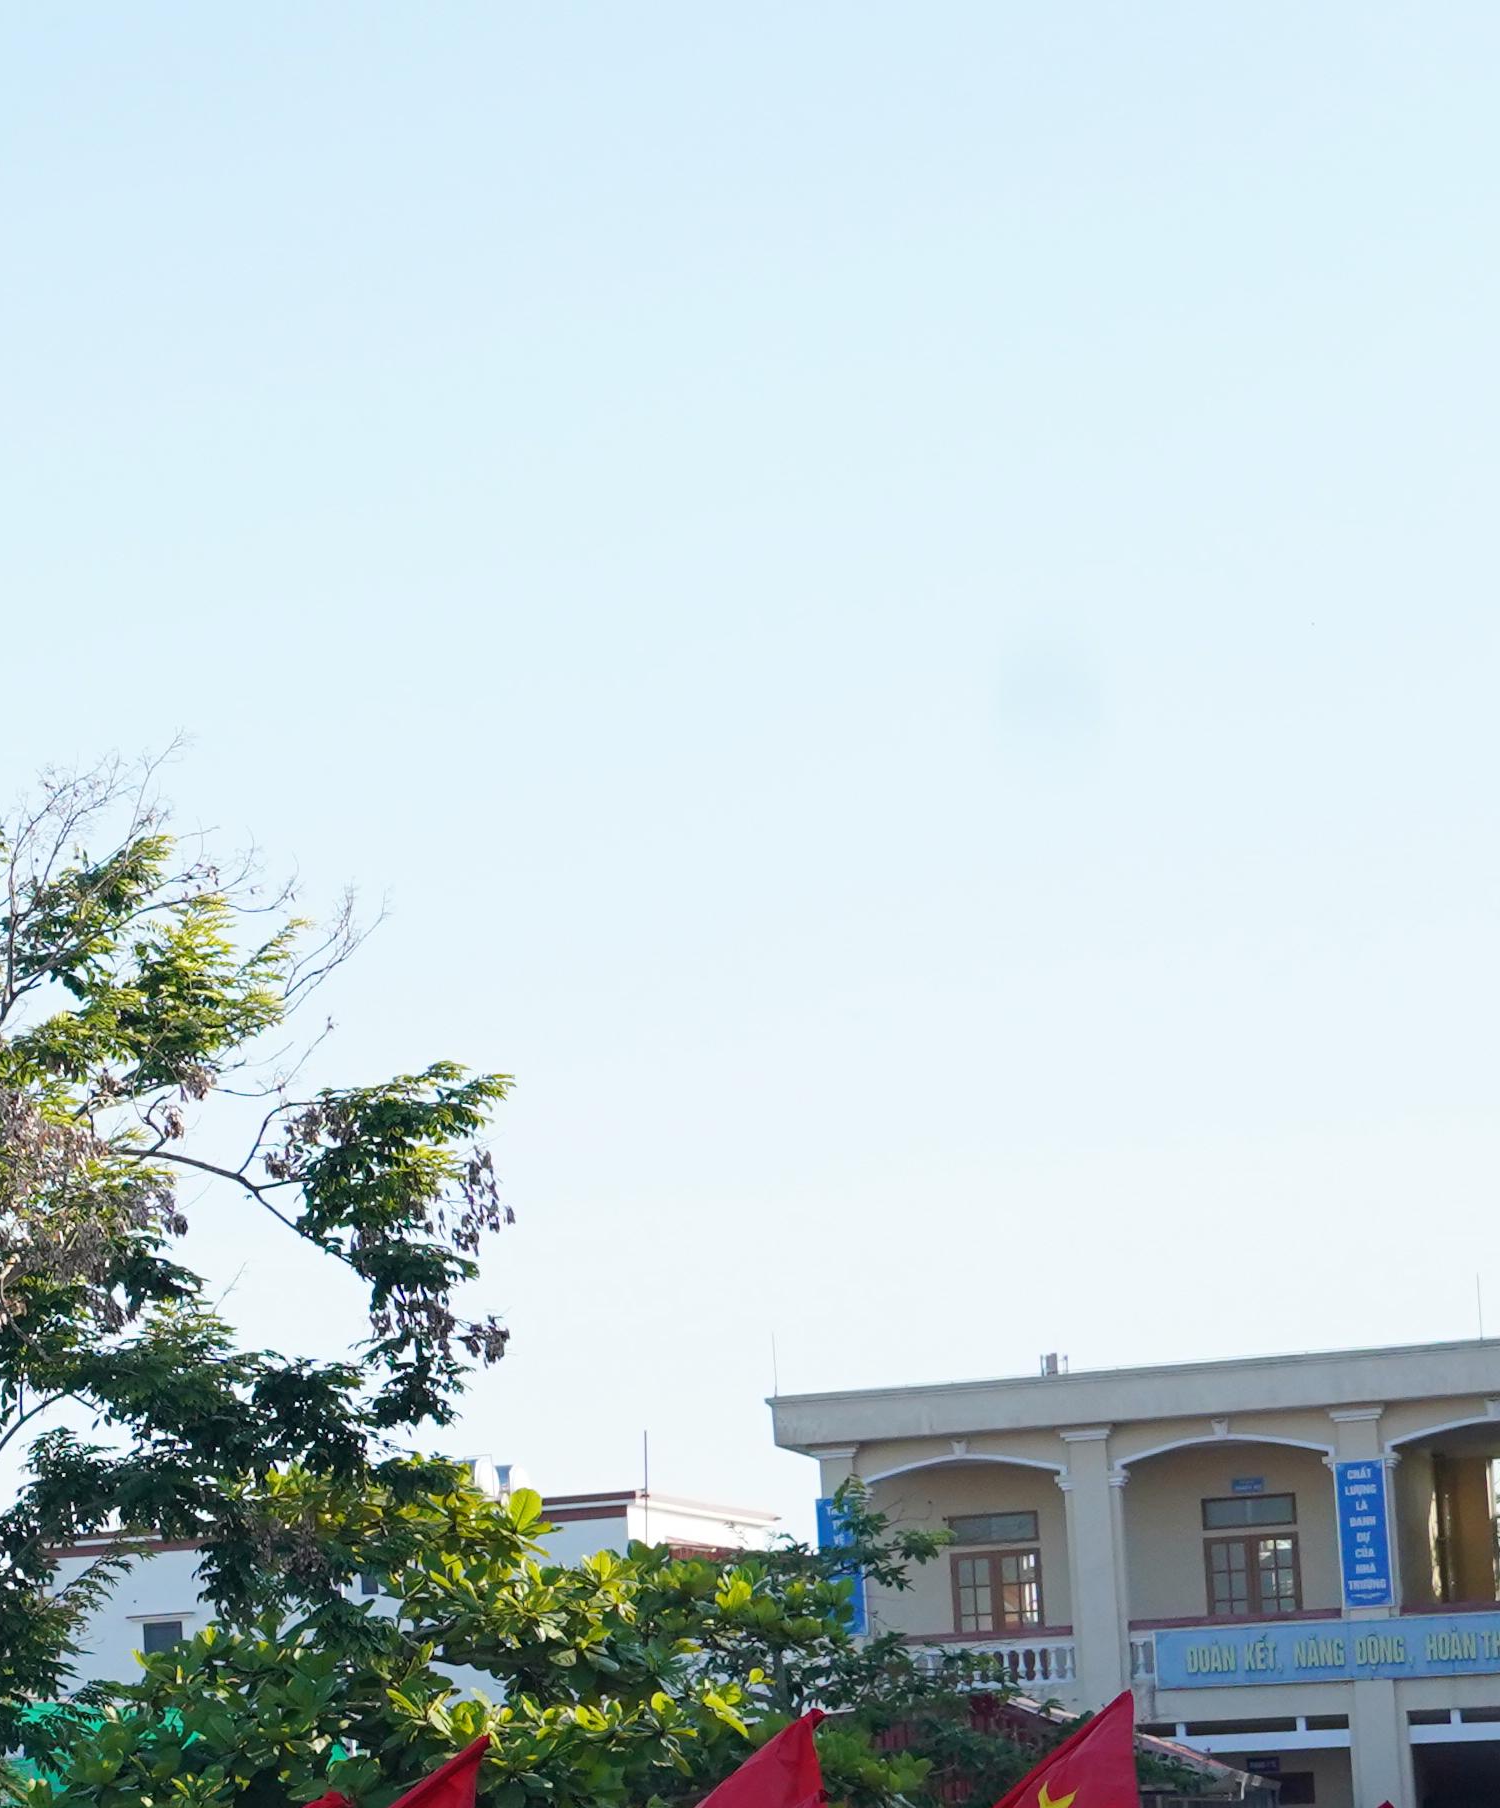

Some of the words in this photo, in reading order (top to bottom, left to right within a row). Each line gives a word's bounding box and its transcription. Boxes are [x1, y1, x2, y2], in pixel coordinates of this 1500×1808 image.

[1347, 1467, 1372, 1480] CHẤT
[1344, 1484, 1377, 1497] LƯỢNG
[1355, 1500, 1368, 1511] LÀ
[1354, 1545, 1375, 1558] CỦA
[1186, 1641, 1236, 1673] ĐOÀN
[1293, 1633, 1345, 1668] NĂNG
